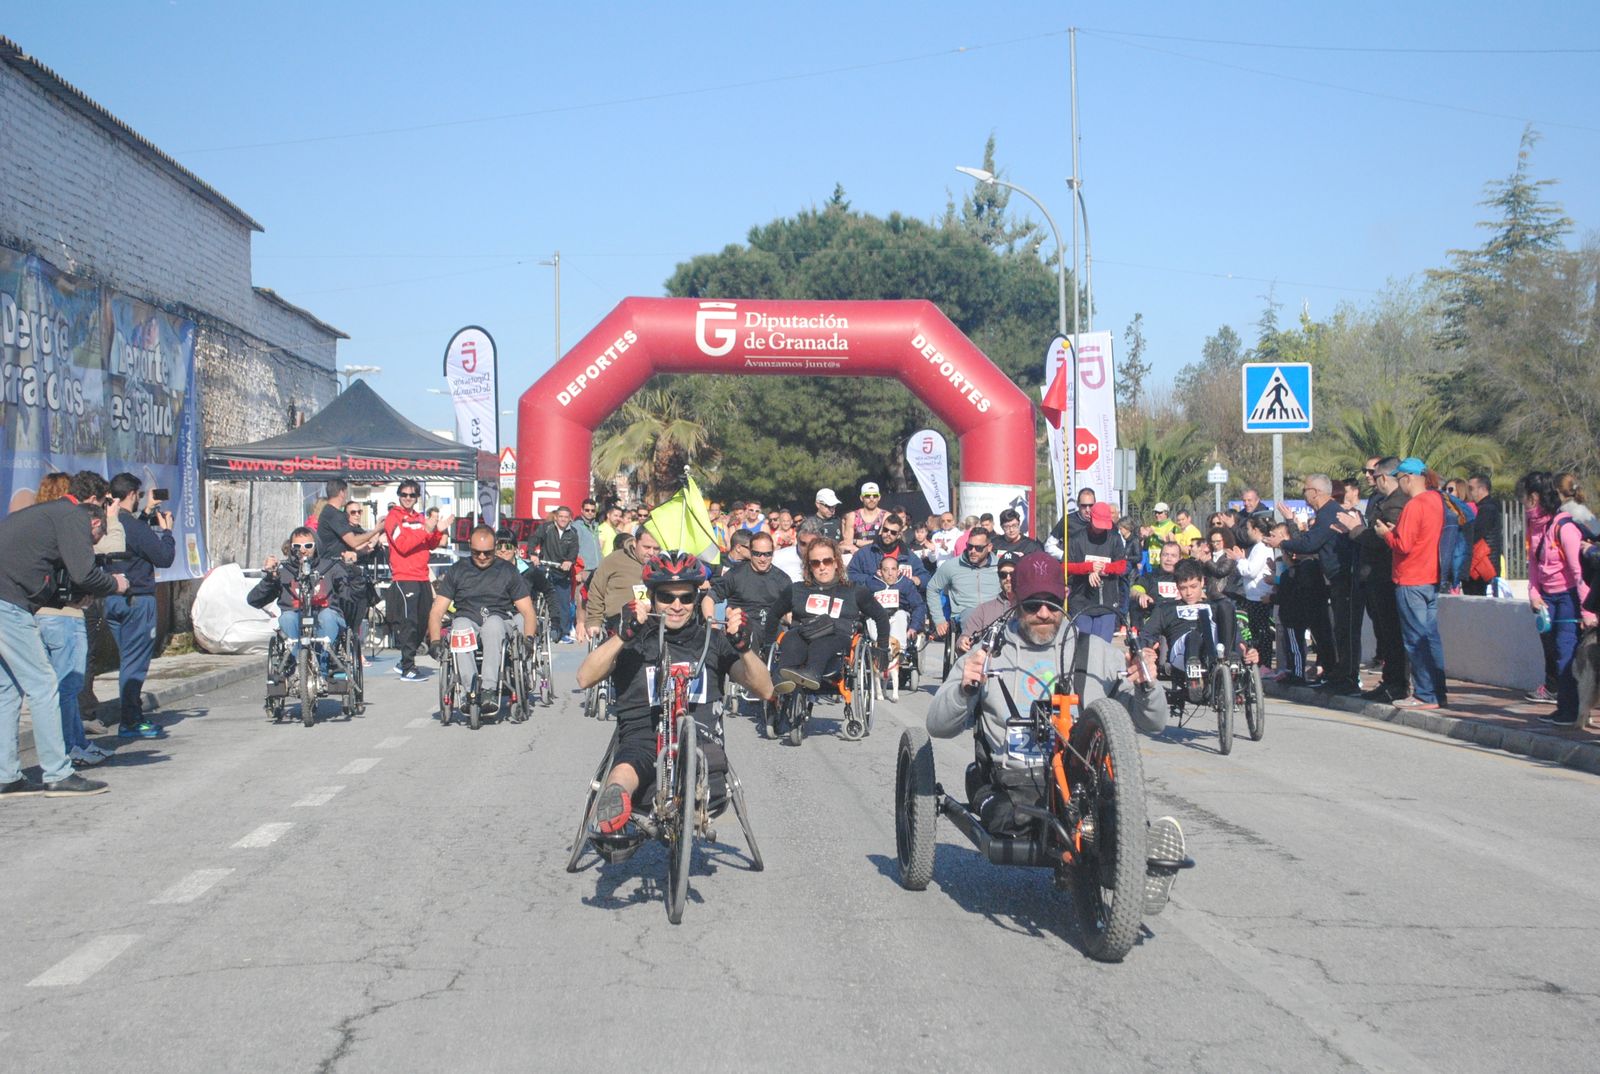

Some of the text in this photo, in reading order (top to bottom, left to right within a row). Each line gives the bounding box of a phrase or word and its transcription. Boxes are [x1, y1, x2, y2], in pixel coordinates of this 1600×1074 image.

[744, 312, 849, 331] Diputación
[744, 332, 849, 351] de Granada
[556, 330, 638, 407] DEPORTES
[744, 359, 841, 369] Avanzamos junt@s
[911, 334, 991, 413] DEPORTES
[111, 391, 173, 436] es Salud
[1077, 443, 1098, 455] OP
[228, 456, 459, 475] www.global-tempo.com
[457, 635, 471, 648] 13
